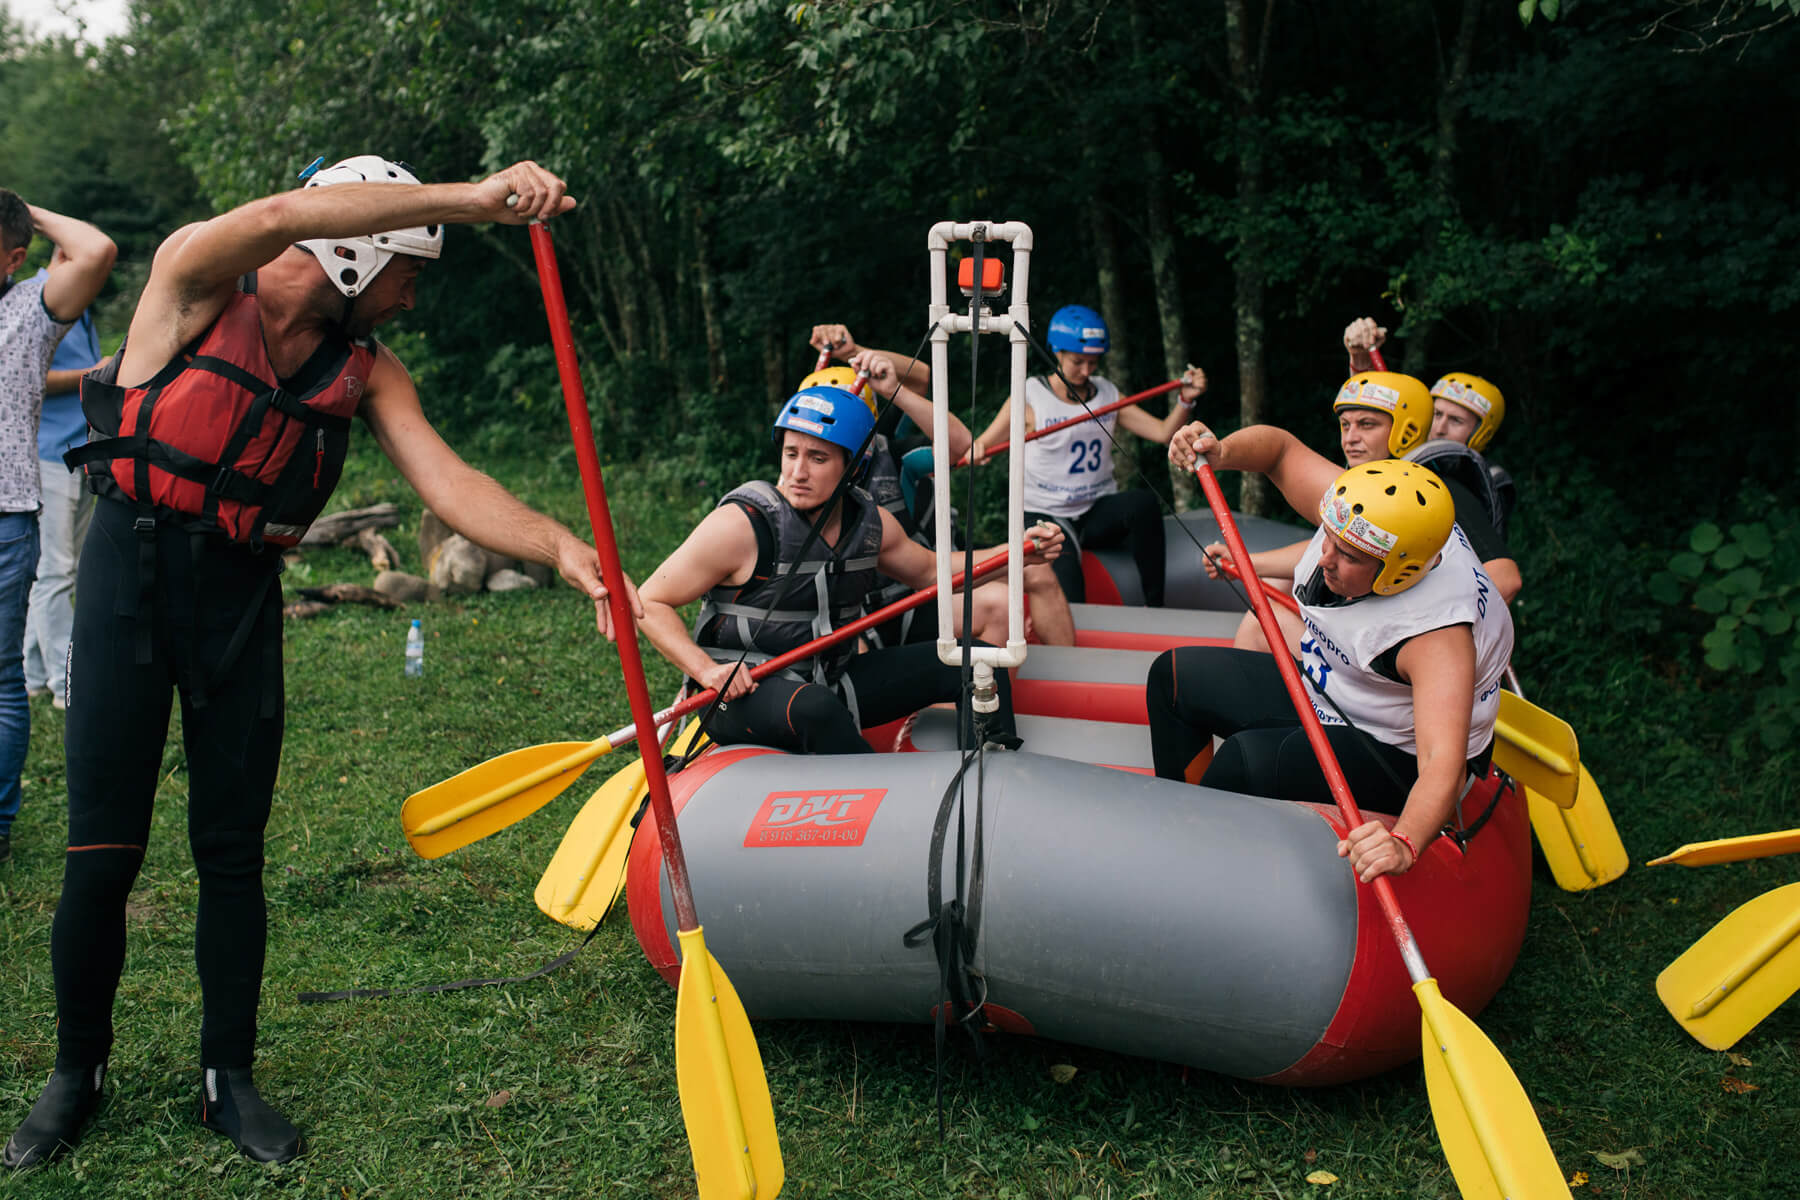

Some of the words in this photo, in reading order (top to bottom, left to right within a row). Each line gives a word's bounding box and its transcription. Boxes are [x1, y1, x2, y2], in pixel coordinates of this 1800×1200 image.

[1068, 439, 1102, 474] 23
[1472, 567, 1489, 620] DNT
[770, 830, 793, 841] 918
[796, 829, 858, 841] 367-01-00
